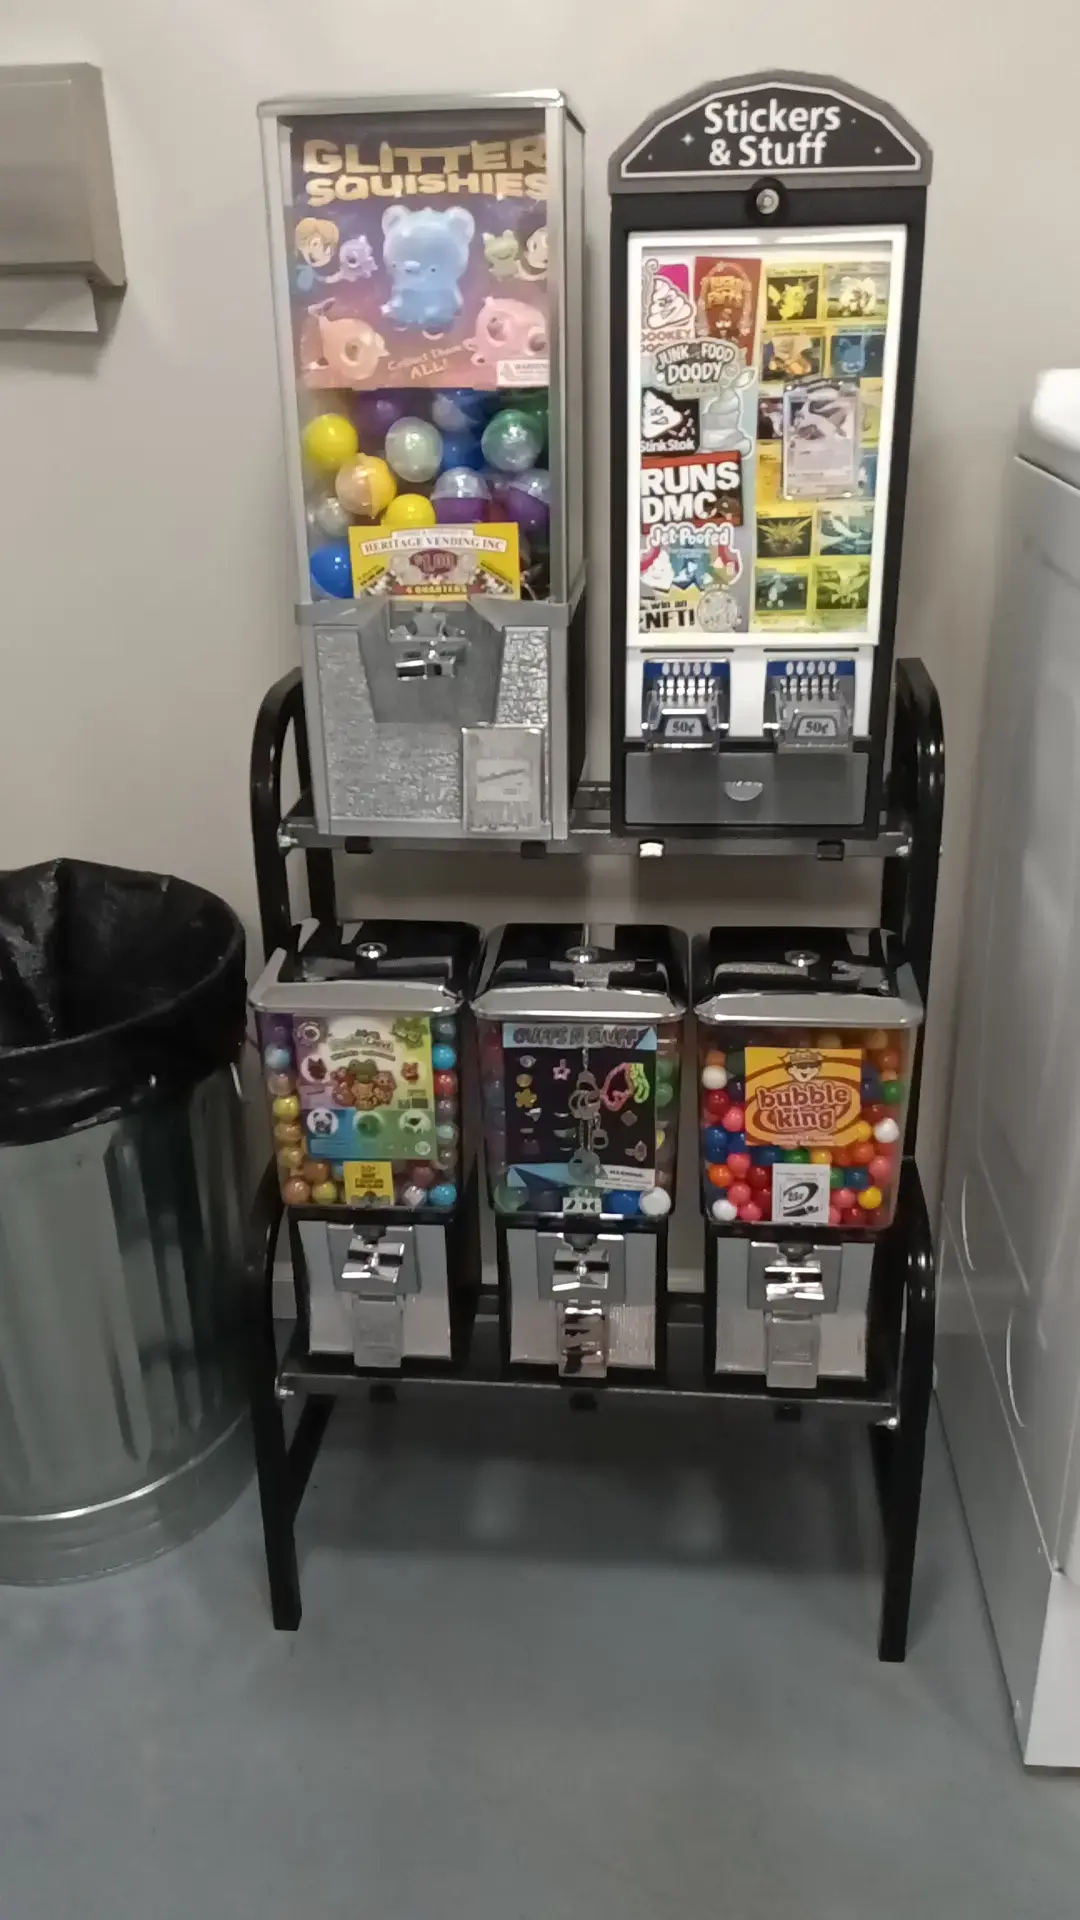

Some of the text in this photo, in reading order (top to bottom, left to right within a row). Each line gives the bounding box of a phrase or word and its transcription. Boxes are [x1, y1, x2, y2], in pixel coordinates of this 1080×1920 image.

[704, 98, 841, 135] Stickers
[302, 135, 547, 173] GLITTER
[709, 131, 828, 167] & Stuff
[305, 171, 548, 207] SQUISHIES
[410, 358, 448, 379] ALL!
[657, 344, 690, 370] JUNK
[701, 342, 734, 362] FOOD
[667, 362, 722, 384] DOODY
[641, 461, 740, 496] RUNS
[641, 491, 718, 525] DMC
[363, 535, 504, 553] HERITAGE VENDING INC
[645, 608, 695, 629] NFT!
[672, 717, 695, 735] 50¢
[805, 717, 829, 735] 50¢
[755, 1081, 850, 1109] bubble
[775, 1106, 836, 1131] king
